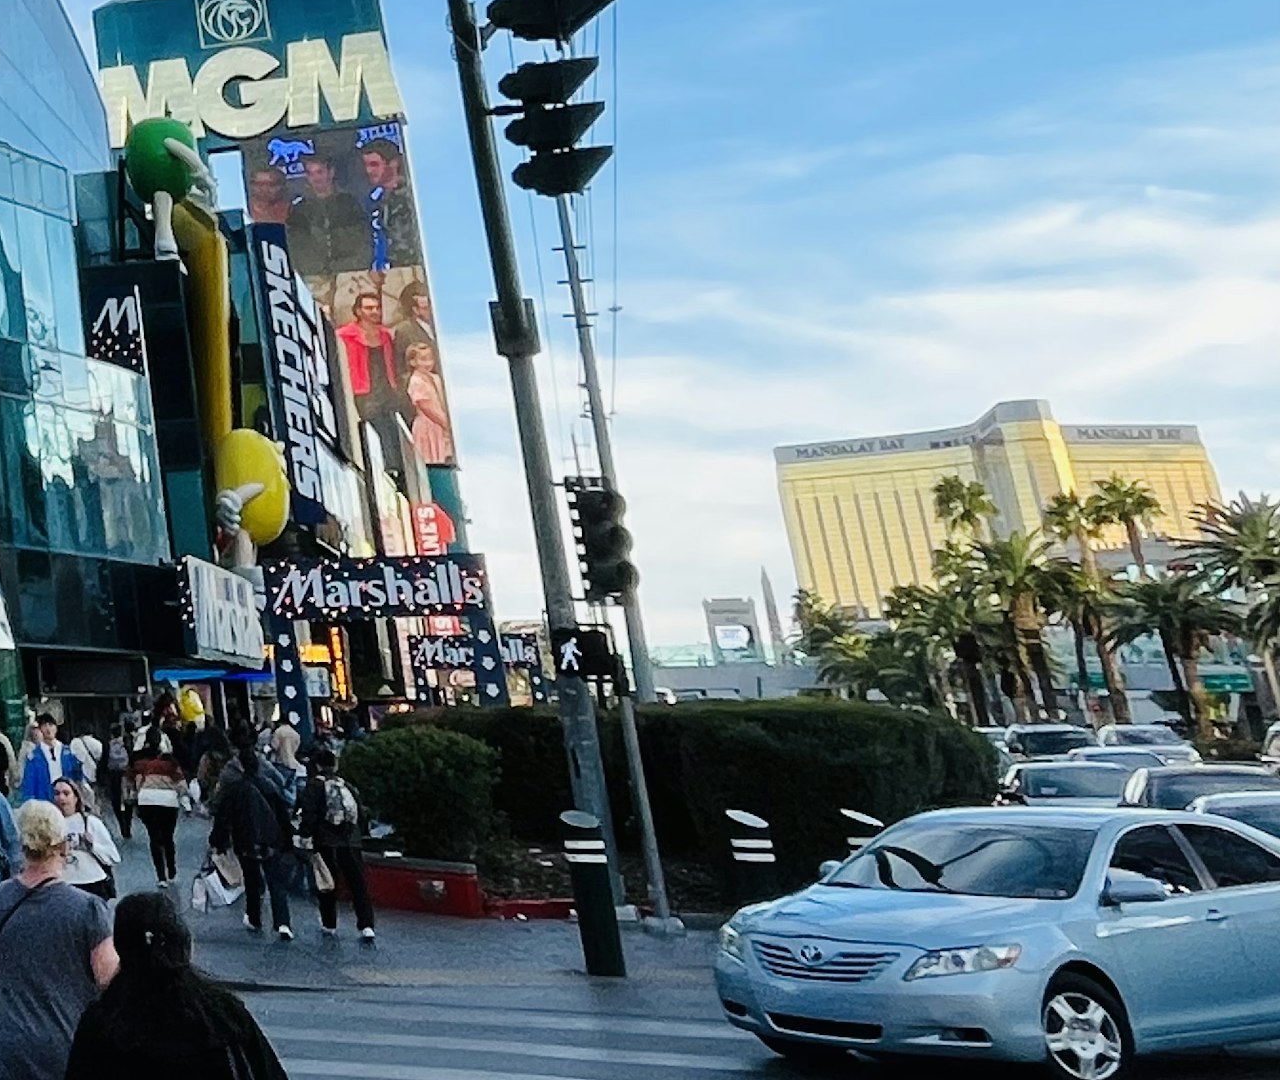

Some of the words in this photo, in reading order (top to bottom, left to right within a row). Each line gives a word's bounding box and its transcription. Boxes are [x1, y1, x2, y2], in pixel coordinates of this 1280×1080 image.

[99, 30, 406, 150] MGM
[260, 240, 322, 504] SKECHERS
[795, 442, 875, 459] MANDALAY
[879, 438, 906, 451] BAY
[272, 560, 484, 611] Marshalls
